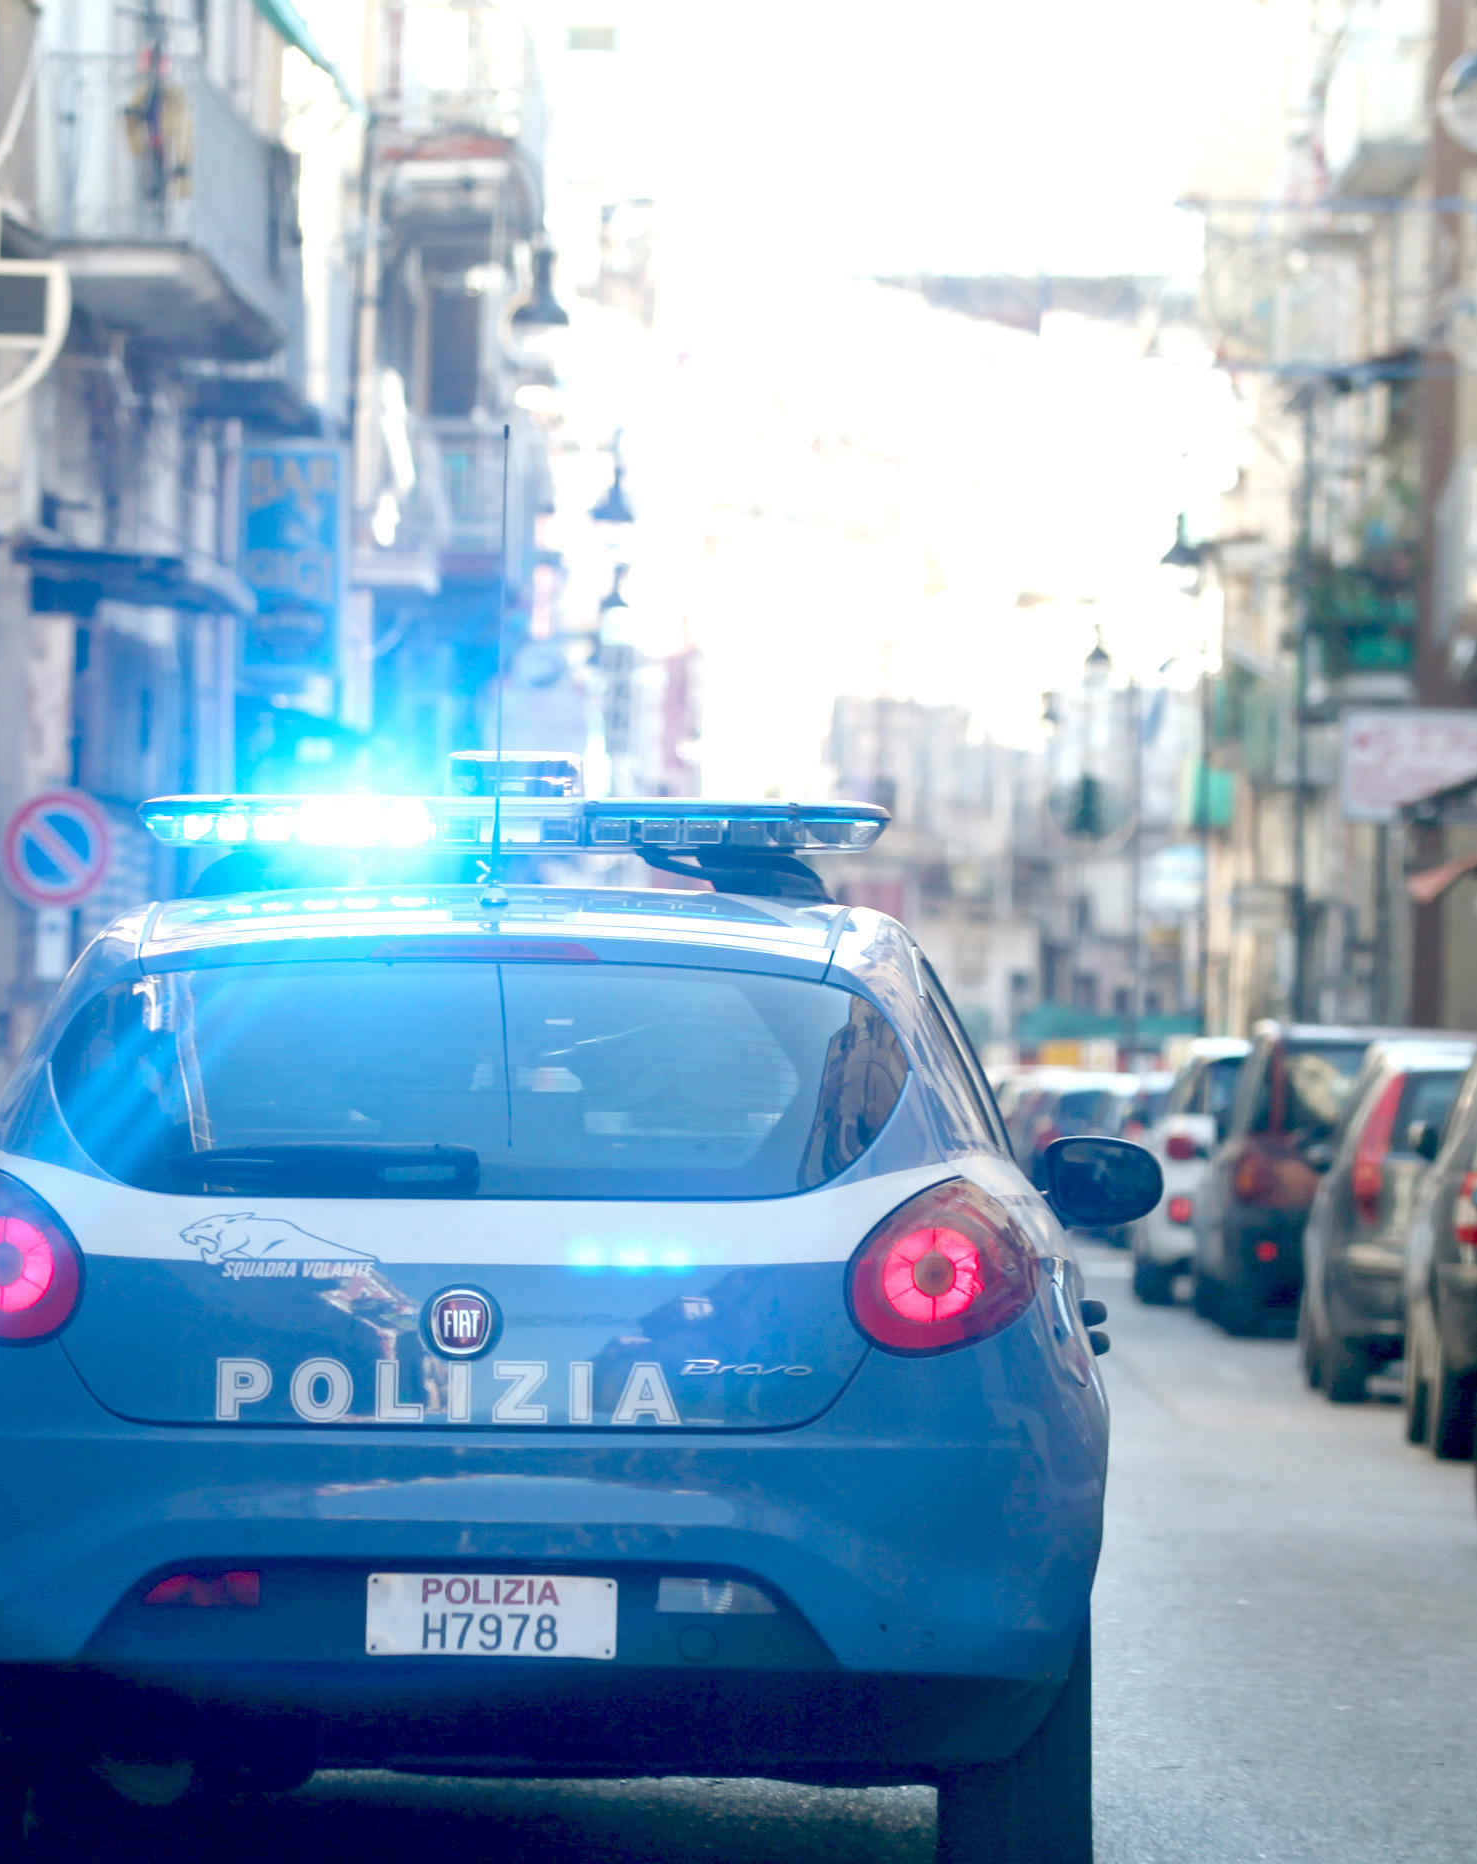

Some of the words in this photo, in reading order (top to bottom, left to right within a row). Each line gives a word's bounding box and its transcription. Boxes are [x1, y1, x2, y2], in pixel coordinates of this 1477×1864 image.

[249, 457, 336, 510] BAR
[222, 1262, 296, 1280] SQUADRA
[302, 1262, 376, 1278] VOLANTE
[443, 1309, 481, 1338] FIAT
[680, 1359, 813, 1376] Bravo
[215, 1358, 681, 1425] POLIZIA
[421, 1578, 559, 1605] POLIZIA
[421, 1612, 558, 1652] H7978
